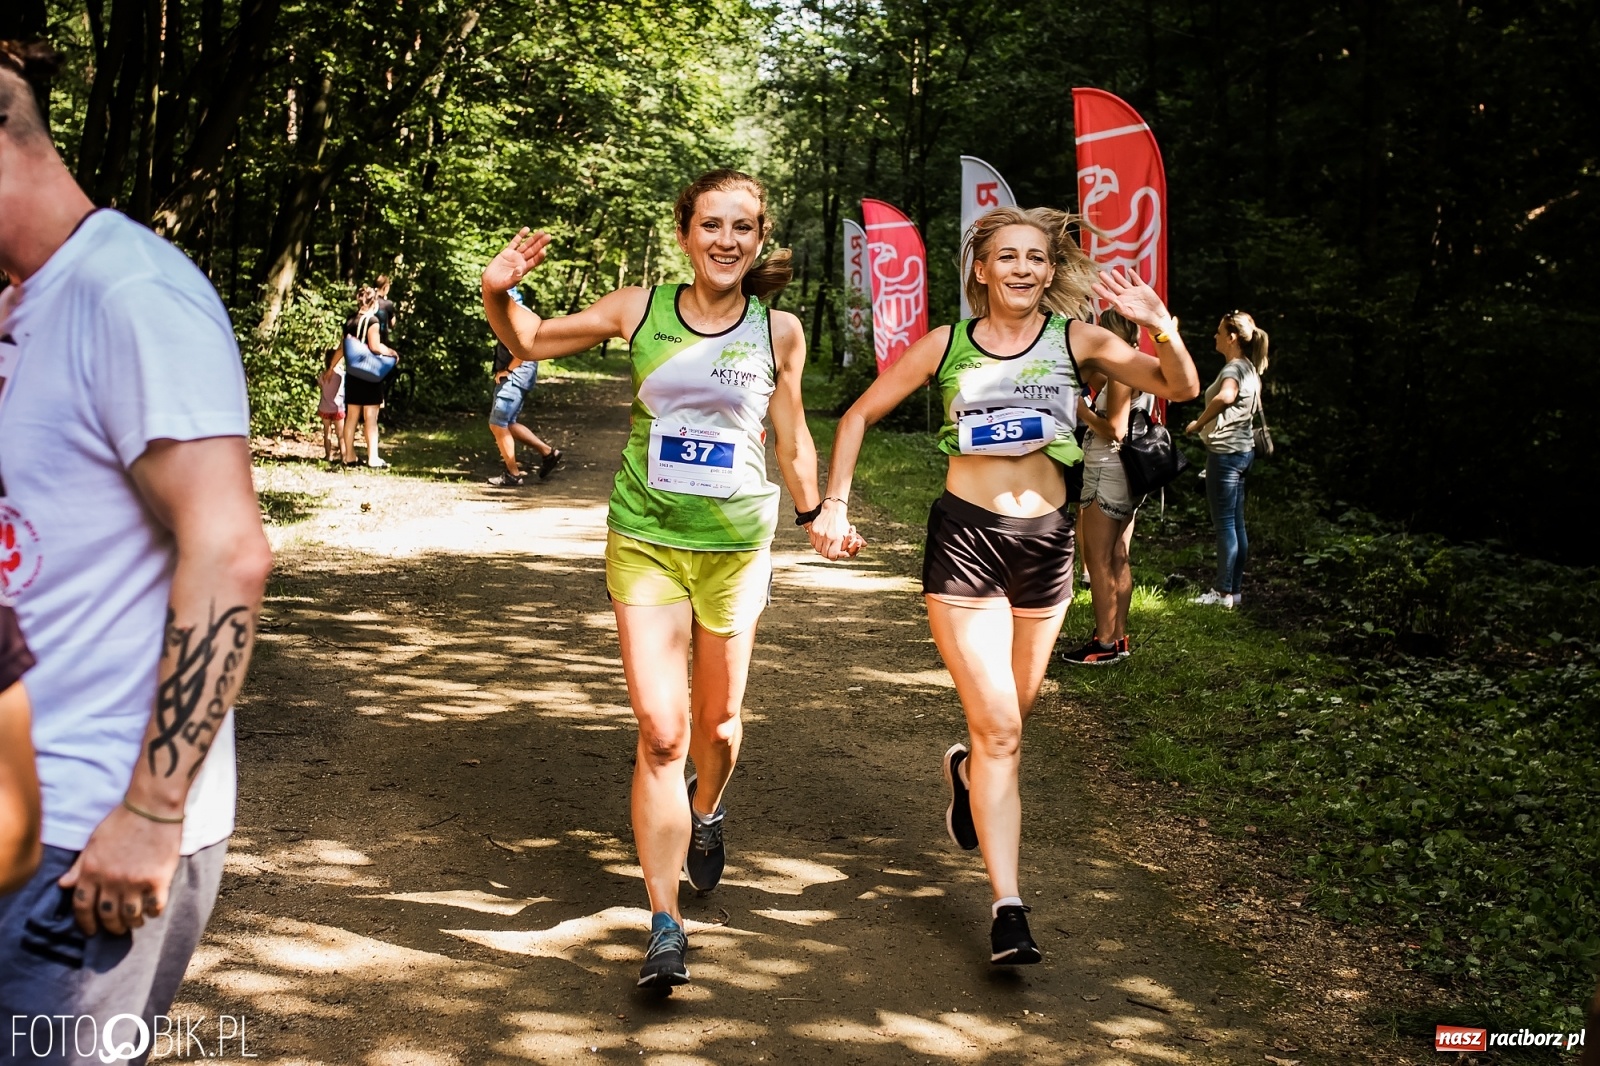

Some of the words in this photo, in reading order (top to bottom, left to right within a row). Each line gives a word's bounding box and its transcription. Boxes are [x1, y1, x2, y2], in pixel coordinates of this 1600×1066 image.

[653, 332, 682, 343] deep
[954, 362, 982, 371] deep
[990, 420, 1023, 441] 35
[680, 440, 715, 463] 37
